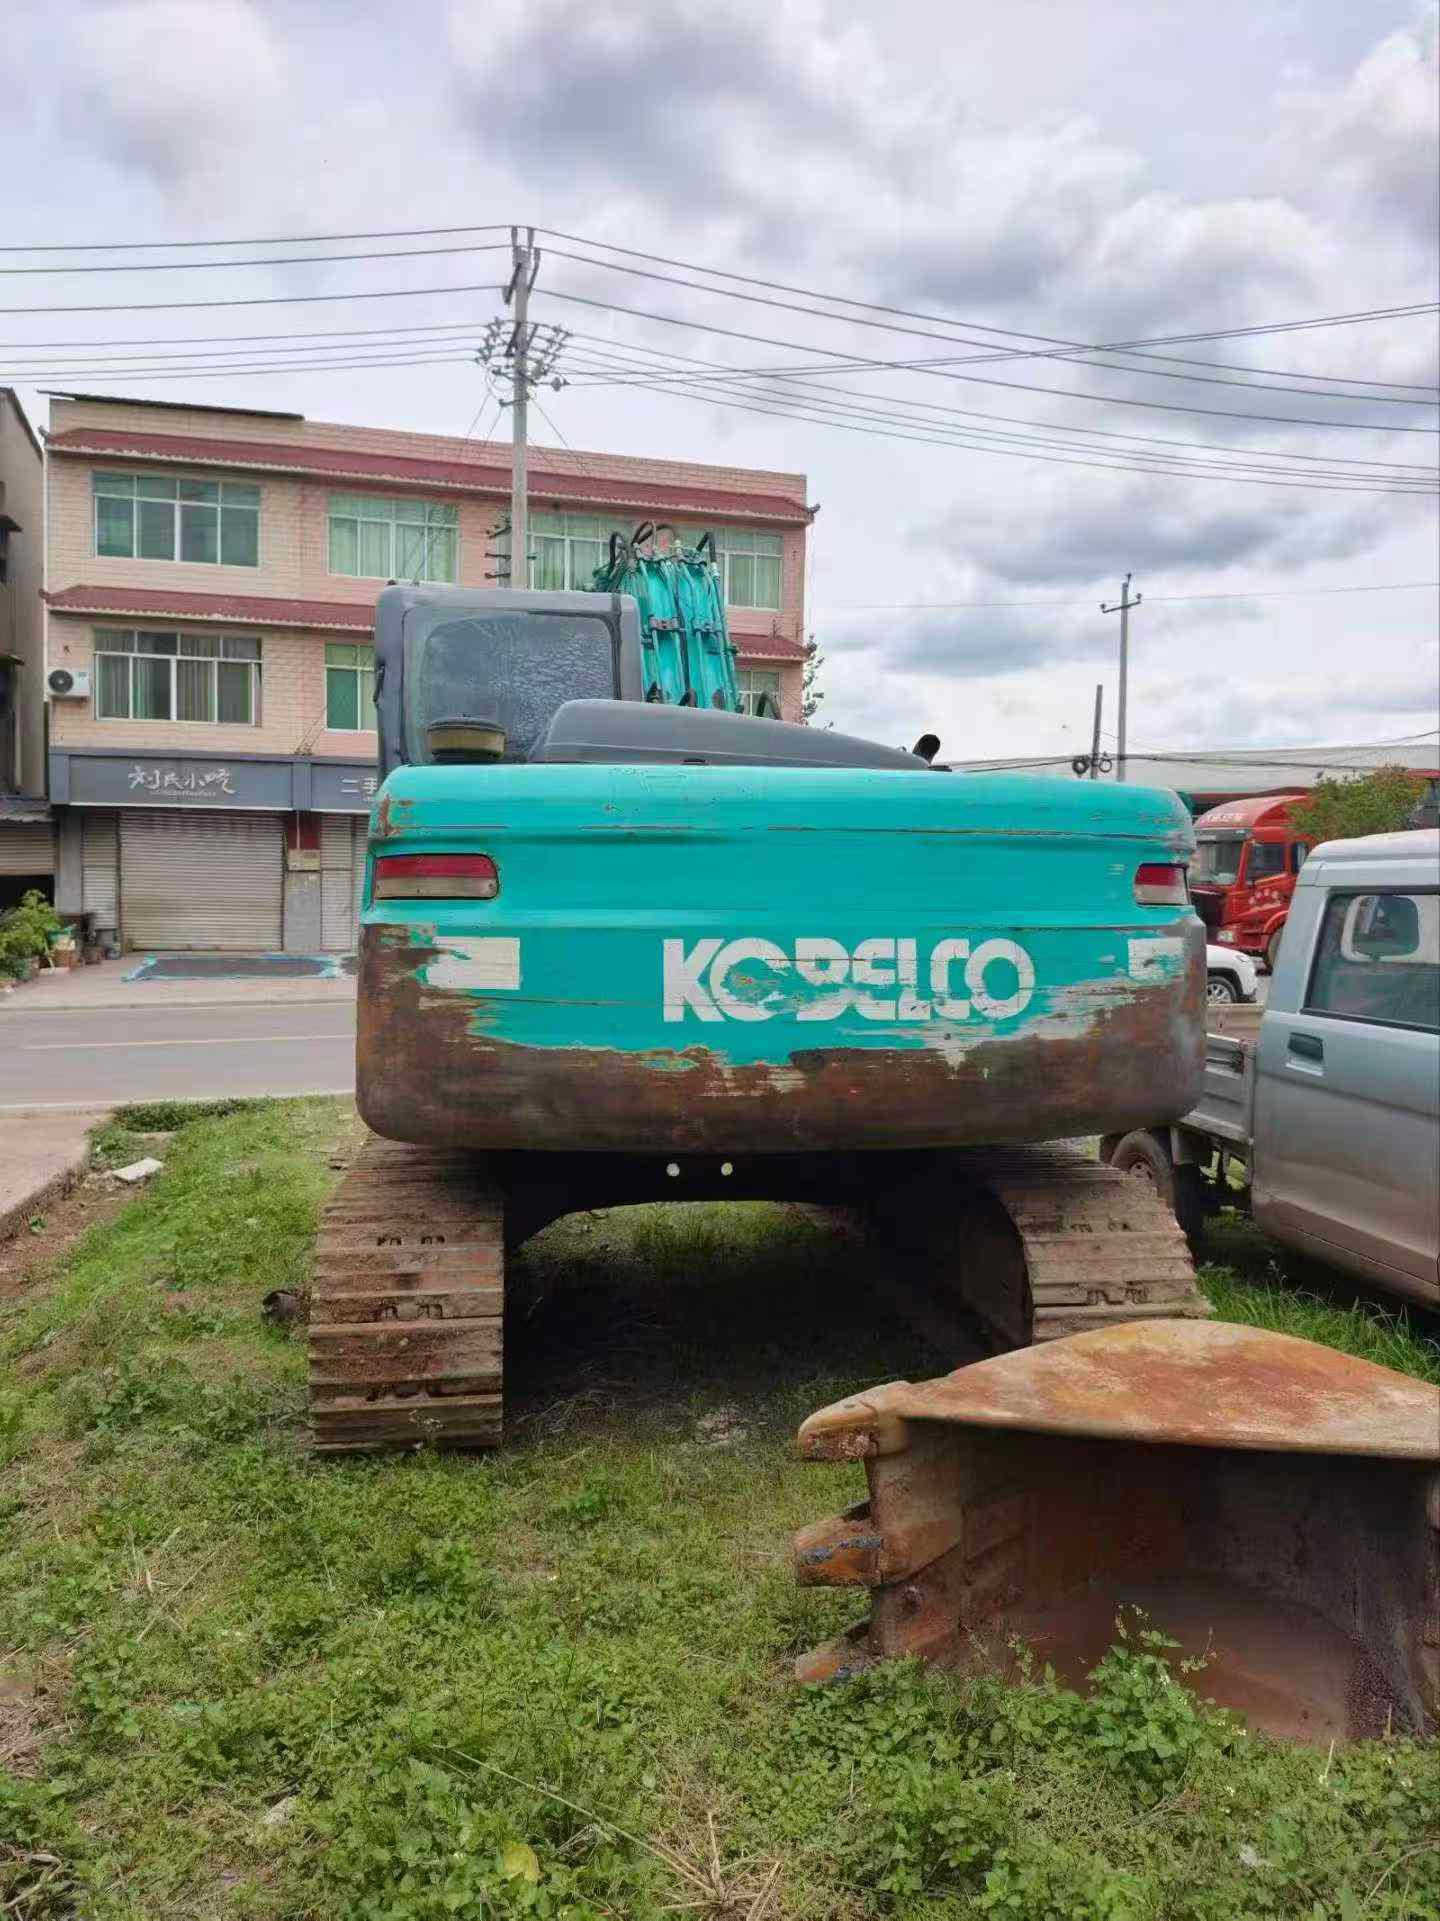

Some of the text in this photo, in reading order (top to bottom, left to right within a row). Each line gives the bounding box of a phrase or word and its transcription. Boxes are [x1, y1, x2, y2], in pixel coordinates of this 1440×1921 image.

[127, 765, 236, 795] 刘氏小吃
[662, 937, 1036, 1022] KOBELCO
